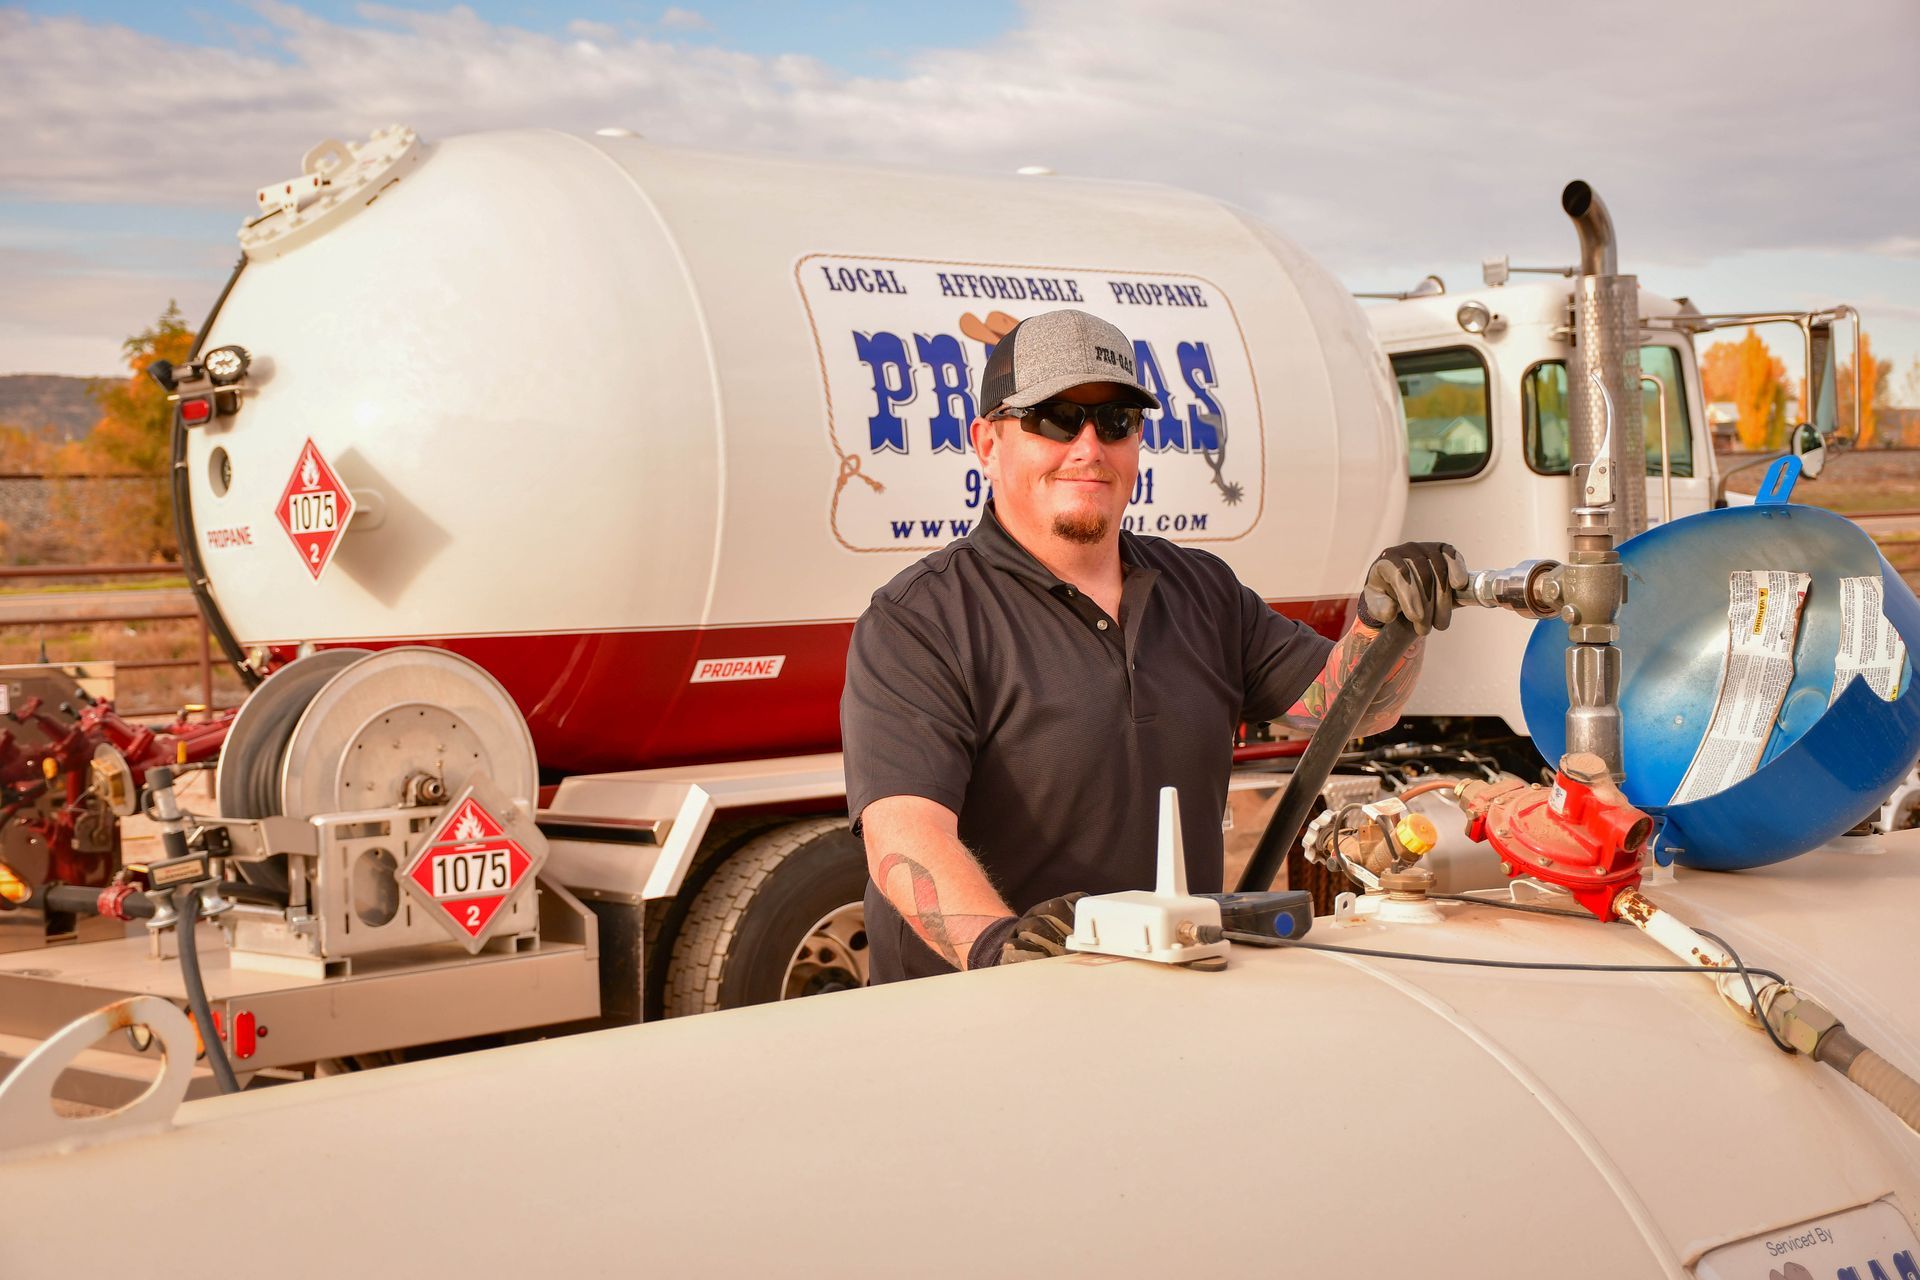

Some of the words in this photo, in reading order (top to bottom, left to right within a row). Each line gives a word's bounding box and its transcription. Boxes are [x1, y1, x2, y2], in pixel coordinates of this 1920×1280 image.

[821, 266, 907, 295] LOCAL
[937, 272, 1084, 303] AFFORDABLE
[1109, 281, 1208, 308] PROPANE
[852, 330, 997, 454] PR
[292, 494, 334, 530] 1075
[207, 526, 253, 548] PROPANE
[309, 543, 321, 563] 2
[1755, 600, 1765, 632] WARNING
[700, 660, 776, 678] PROPANE
[437, 852, 507, 894] 1075
[466, 905, 480, 926] 2
[1766, 1231, 1817, 1257] Serviced
[1814, 1227, 1834, 1245] By
